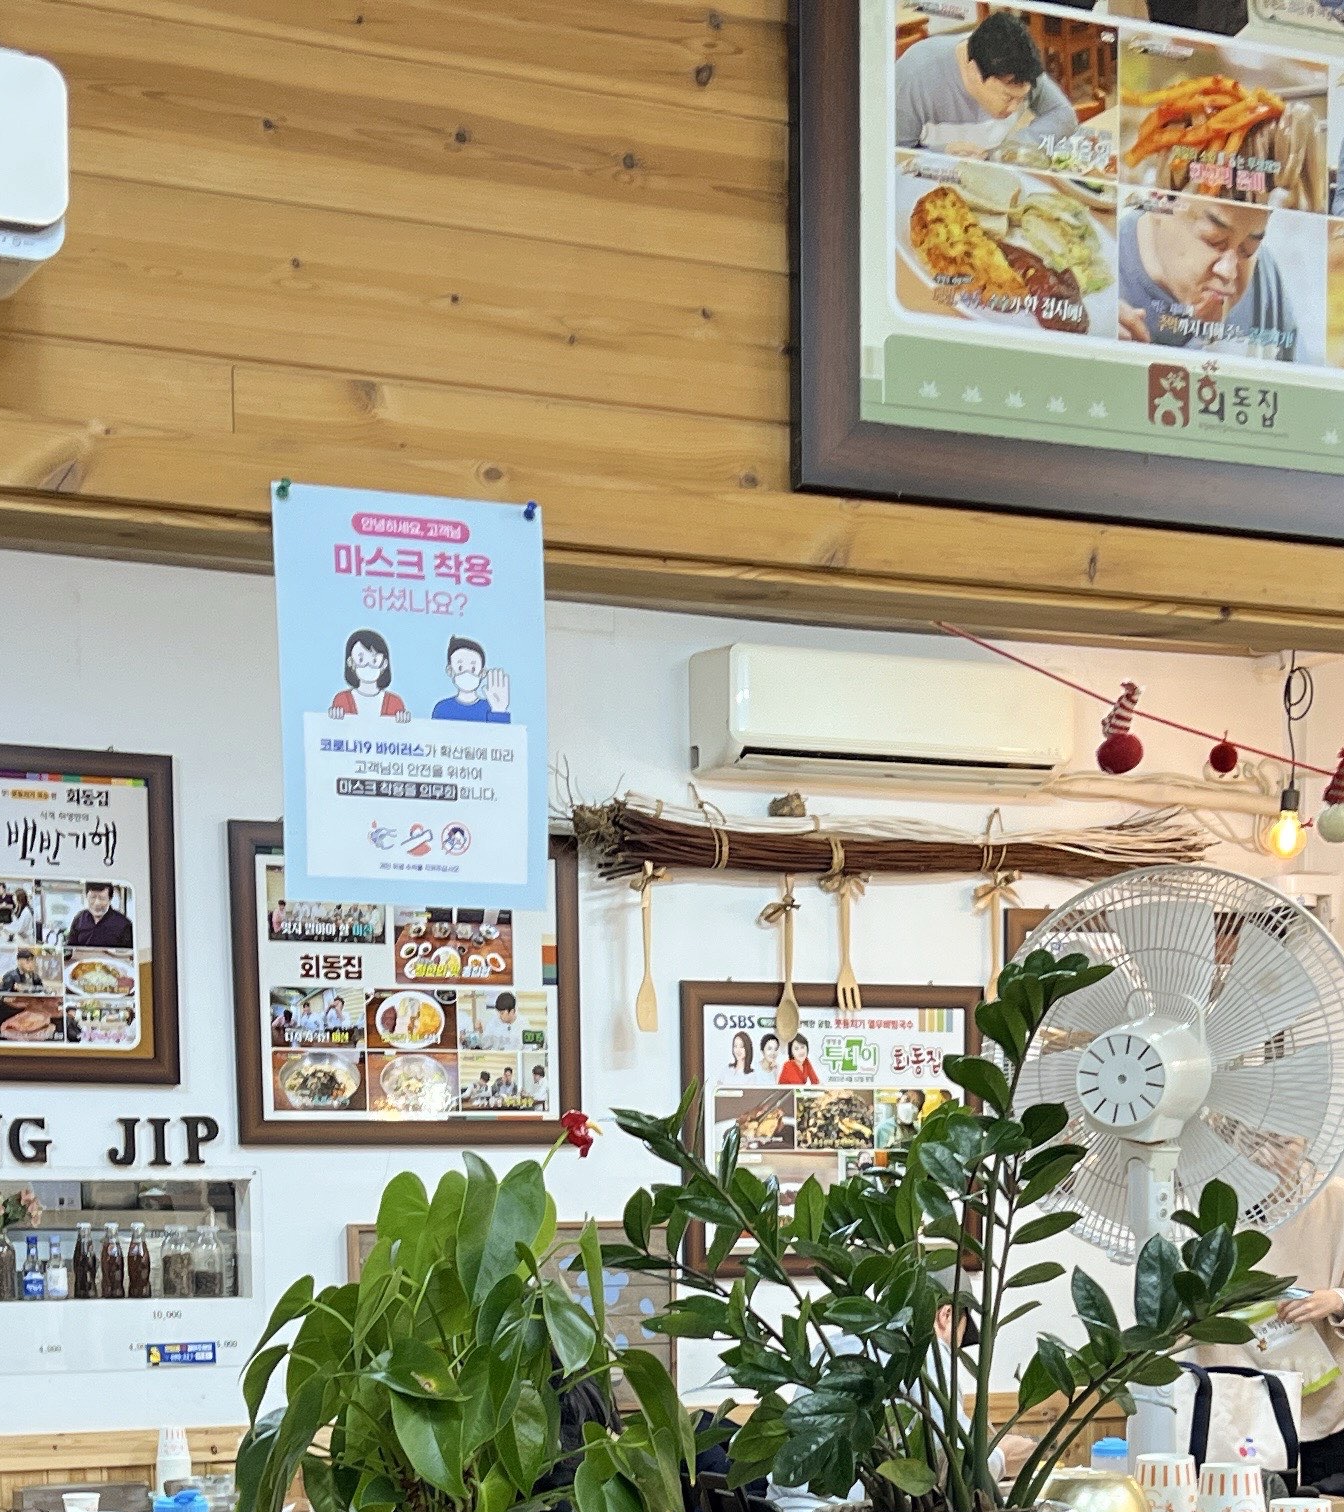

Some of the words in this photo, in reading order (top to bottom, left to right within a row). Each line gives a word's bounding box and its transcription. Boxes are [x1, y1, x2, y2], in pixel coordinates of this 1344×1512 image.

[1196, 372, 1279, 430] 회동집
[333, 543, 426, 582] 마스크
[433, 551, 493, 588] 착용
[361, 585, 469, 618] 하셨나요?
[490, 747, 515, 763] 따라
[66, 787, 110, 807] 회동집
[338, 779, 377, 794] 마스크
[6, 815, 118, 867] 백반기행
[299, 954, 363, 981] 회동집
[729, 1014, 755, 1029] SBS
[892, 1046, 943, 1076] 회동집
[108, 1115, 220, 1168] JIP
